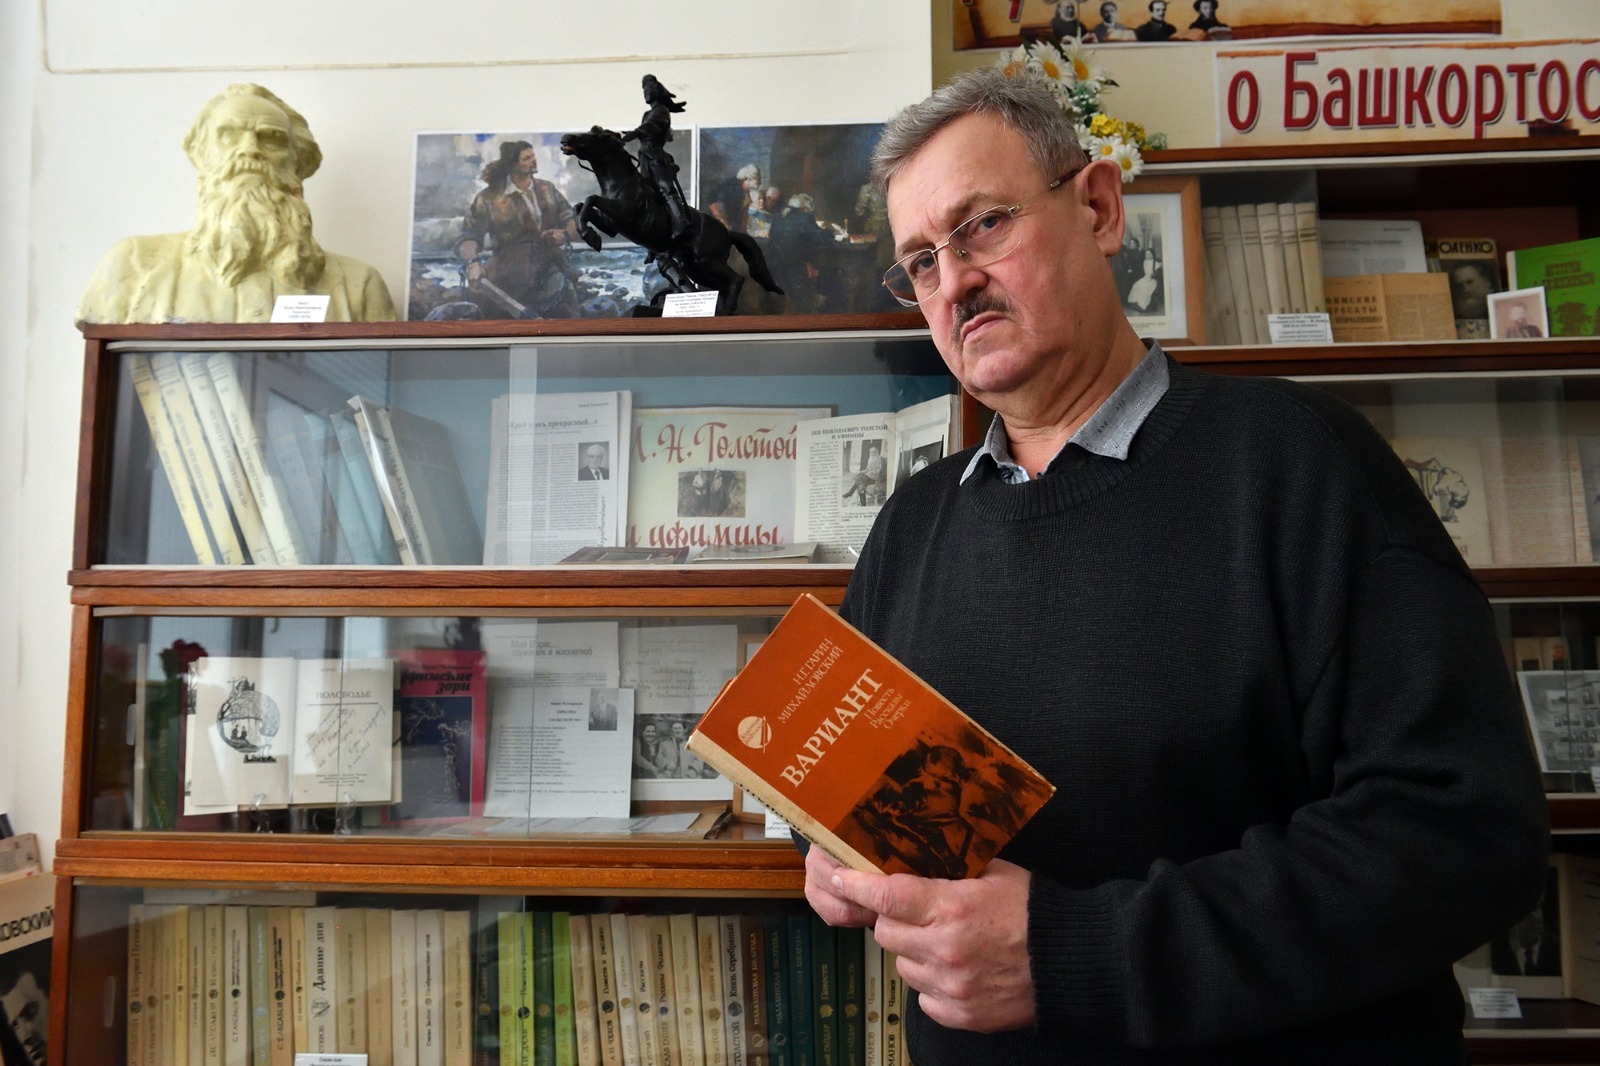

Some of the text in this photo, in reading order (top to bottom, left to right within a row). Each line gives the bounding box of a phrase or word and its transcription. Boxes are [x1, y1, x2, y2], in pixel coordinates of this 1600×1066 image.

[1227, 70, 1260, 133] о
[693, 422, 798, 463] Толстой
[316, 690, 372, 699] ПОЛОВОДЬЕ
[777, 645, 844, 724] МИХАЙЛОВСКИЙ
[864, 688, 895, 720] Повесть
[870, 694, 904, 729] Рассказы
[884, 700, 912, 730] Очерки
[780, 668, 883, 788] ВАРИАНТ
[0, 904, 54, 942] ОВСКИЙ
[315, 922, 325, 943] дни
[726, 922, 737, 972] Серебряный
[312, 946, 326, 991] Давние
[638, 961, 646, 992] Рассказы
[750, 932, 760, 1025] МАЛАХИТОВАЯ ШКАТУЛКА
[772, 931, 783, 1024] МАЛАХИТОВАЯ ШКАТУЛКА
[821, 963, 829, 1000] Повести
[888, 979, 896, 1007] Чапаев
